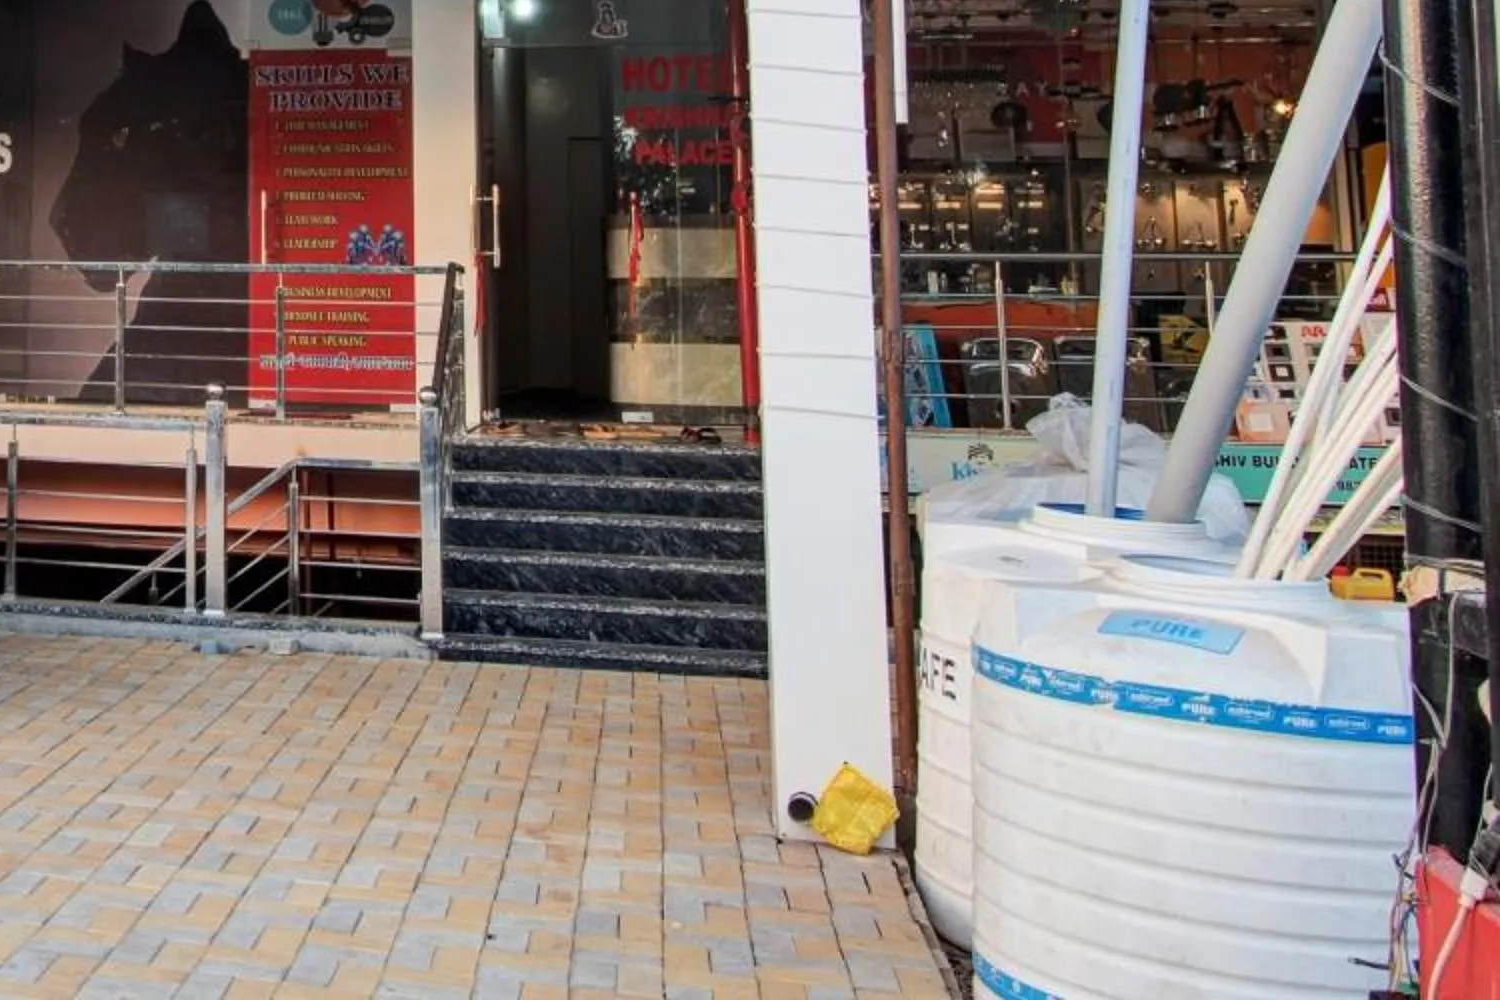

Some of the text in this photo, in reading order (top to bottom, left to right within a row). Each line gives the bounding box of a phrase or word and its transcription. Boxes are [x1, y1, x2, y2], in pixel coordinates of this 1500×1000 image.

[255, 63, 352, 87] SKILLS
[622, 53, 734, 93] HOTEL
[270, 88, 403, 113] PROVIDE
[633, 138, 734, 166] PALACE
[1130, 616, 1206, 641] PURE
